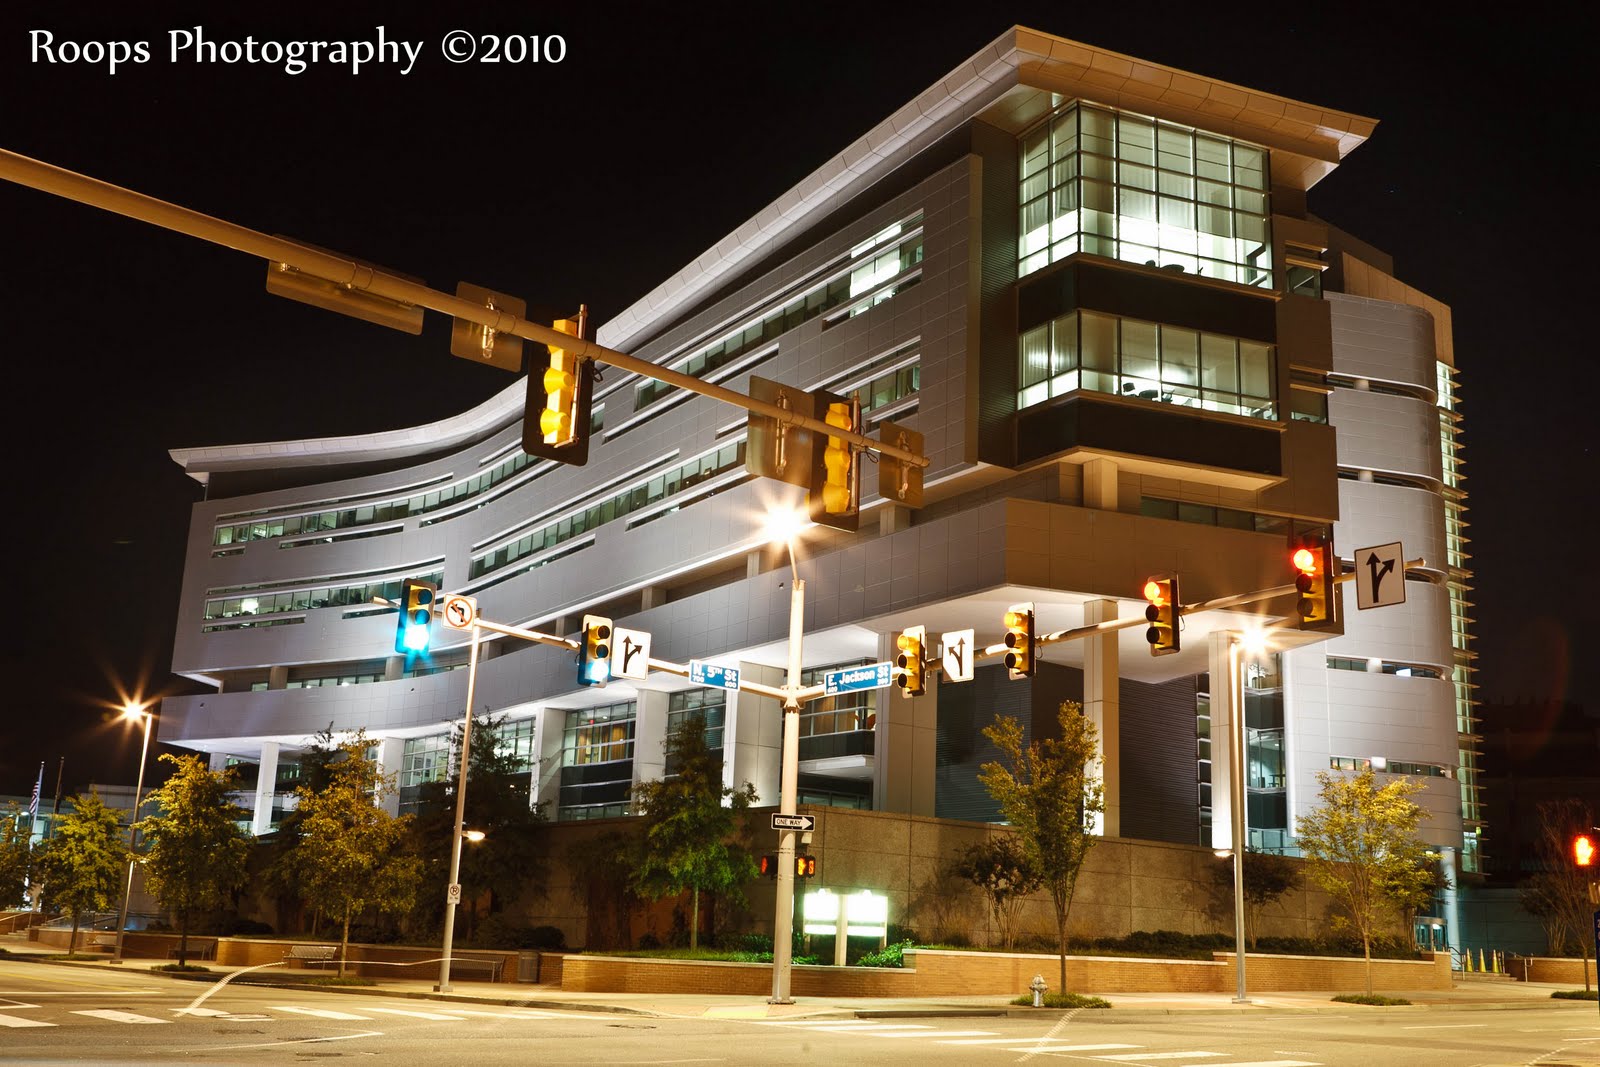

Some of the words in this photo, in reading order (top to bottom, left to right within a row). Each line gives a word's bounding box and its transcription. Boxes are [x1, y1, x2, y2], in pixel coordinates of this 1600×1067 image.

[693, 663, 705, 676] N.
[724, 669, 737, 681] St
[827, 674, 838, 686] E.
[839, 669, 876, 684] Jackson
[877, 665, 889, 678] St
